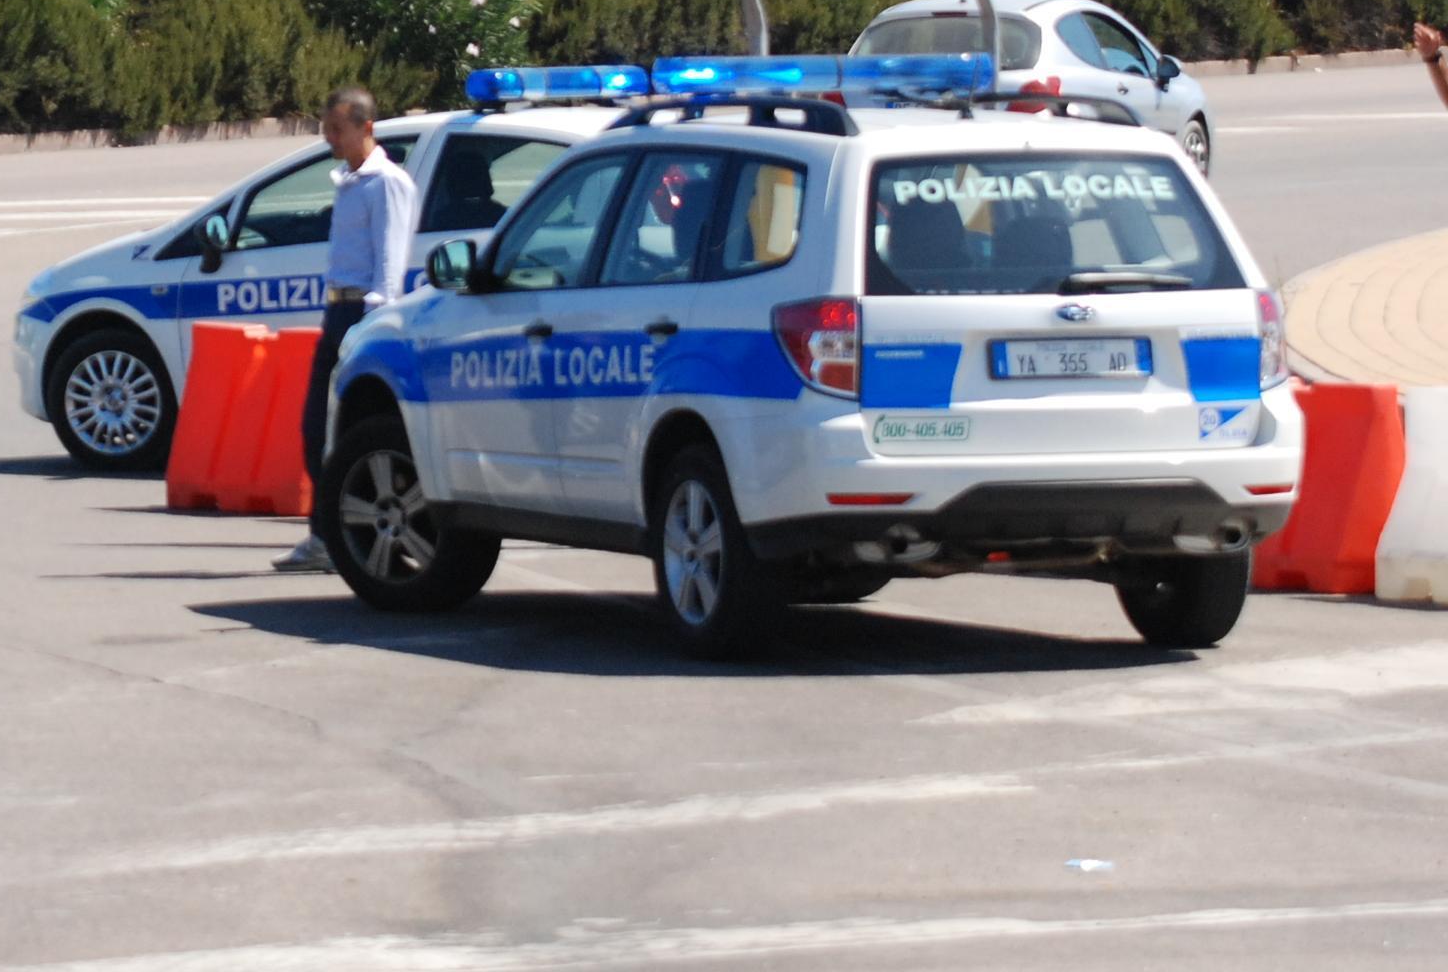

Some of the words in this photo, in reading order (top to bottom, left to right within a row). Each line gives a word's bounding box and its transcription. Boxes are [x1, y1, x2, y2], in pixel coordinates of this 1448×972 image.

[893, 176, 1037, 205] POLIZIA
[1044, 174, 1177, 200] LOCALE
[451, 345, 543, 388] POLIZIA
[554, 344, 656, 386] LOCALE
[1017, 354, 1036, 373] YA
[1058, 353, 1088, 372] 355
